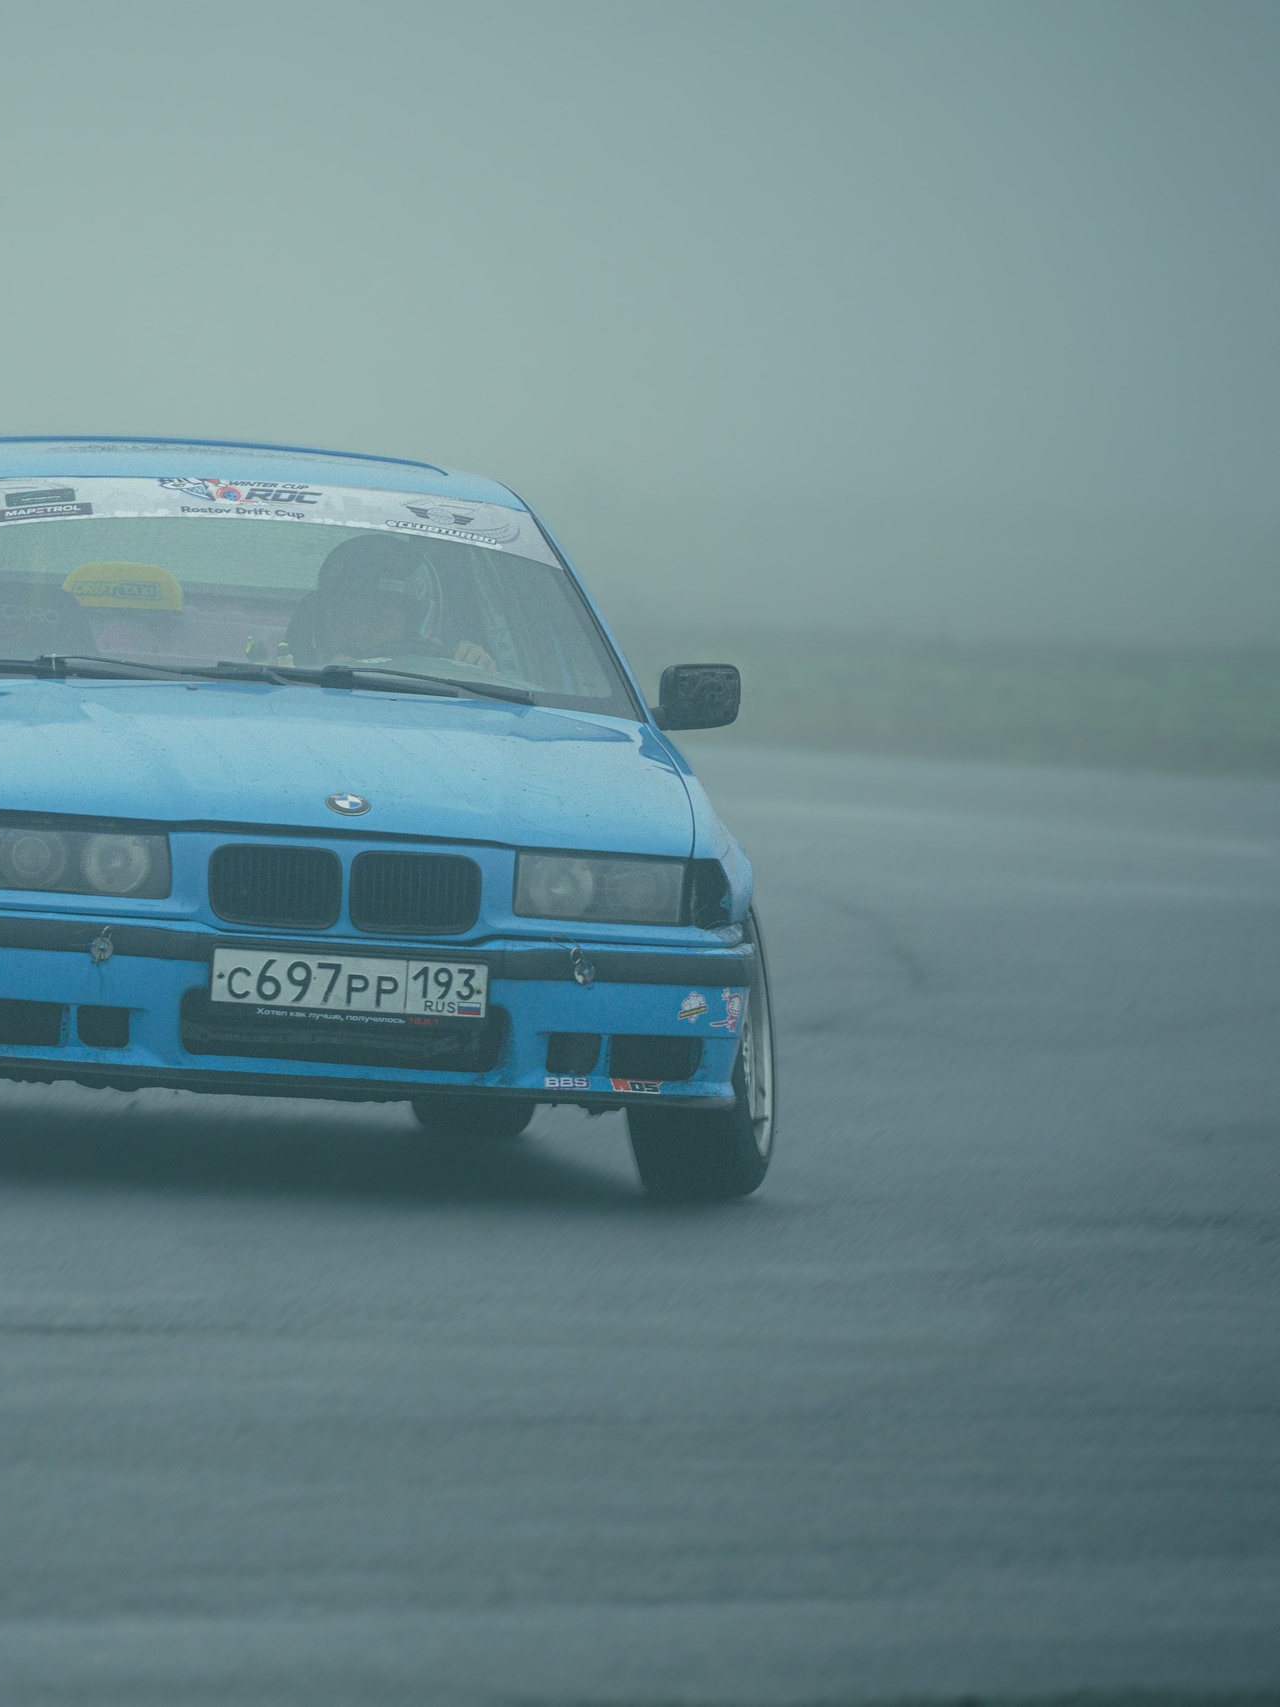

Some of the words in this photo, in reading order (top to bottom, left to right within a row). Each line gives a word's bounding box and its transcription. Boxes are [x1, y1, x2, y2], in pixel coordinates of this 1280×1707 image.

[229, 480, 278, 488] WINTER
[244, 488, 322, 505] RDC
[4, 505, 81, 517] MAPETROL
[180, 505, 231, 514] Rostov
[236, 507, 271, 516] Drift
[274, 509, 306, 519] Cup
[411, 965, 476, 1001] 193
[423, 1000, 456, 1013] RUS
[256, 1007, 287, 1016] Хотел
[308, 1012, 344, 1022] лучше,
[345, 1014, 406, 1024] получилось
[545, 1077, 588, 1088] BBS
[610, 1078, 661, 1093] NOS
